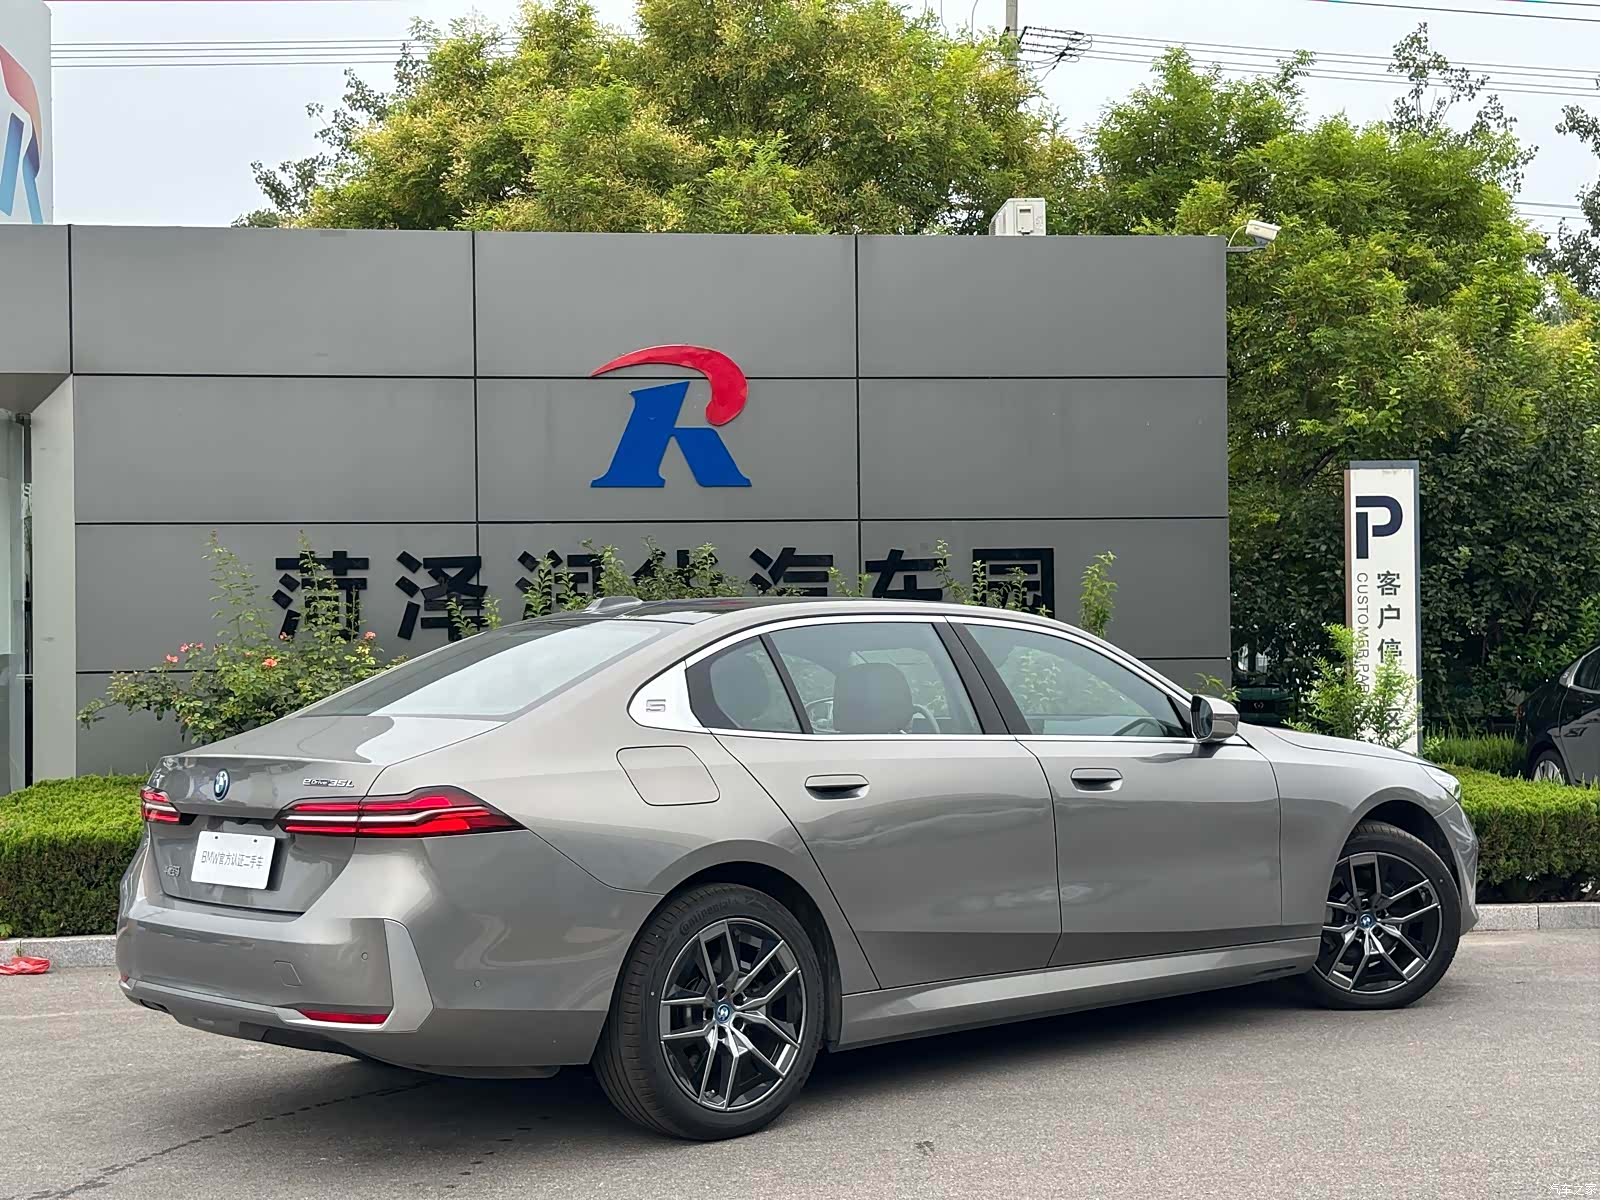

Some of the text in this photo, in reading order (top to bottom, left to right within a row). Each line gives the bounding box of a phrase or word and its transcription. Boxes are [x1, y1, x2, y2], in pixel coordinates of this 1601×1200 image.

[1355, 495, 1403, 559] P
[200, 850, 264, 869] BMW官方认证二手车
